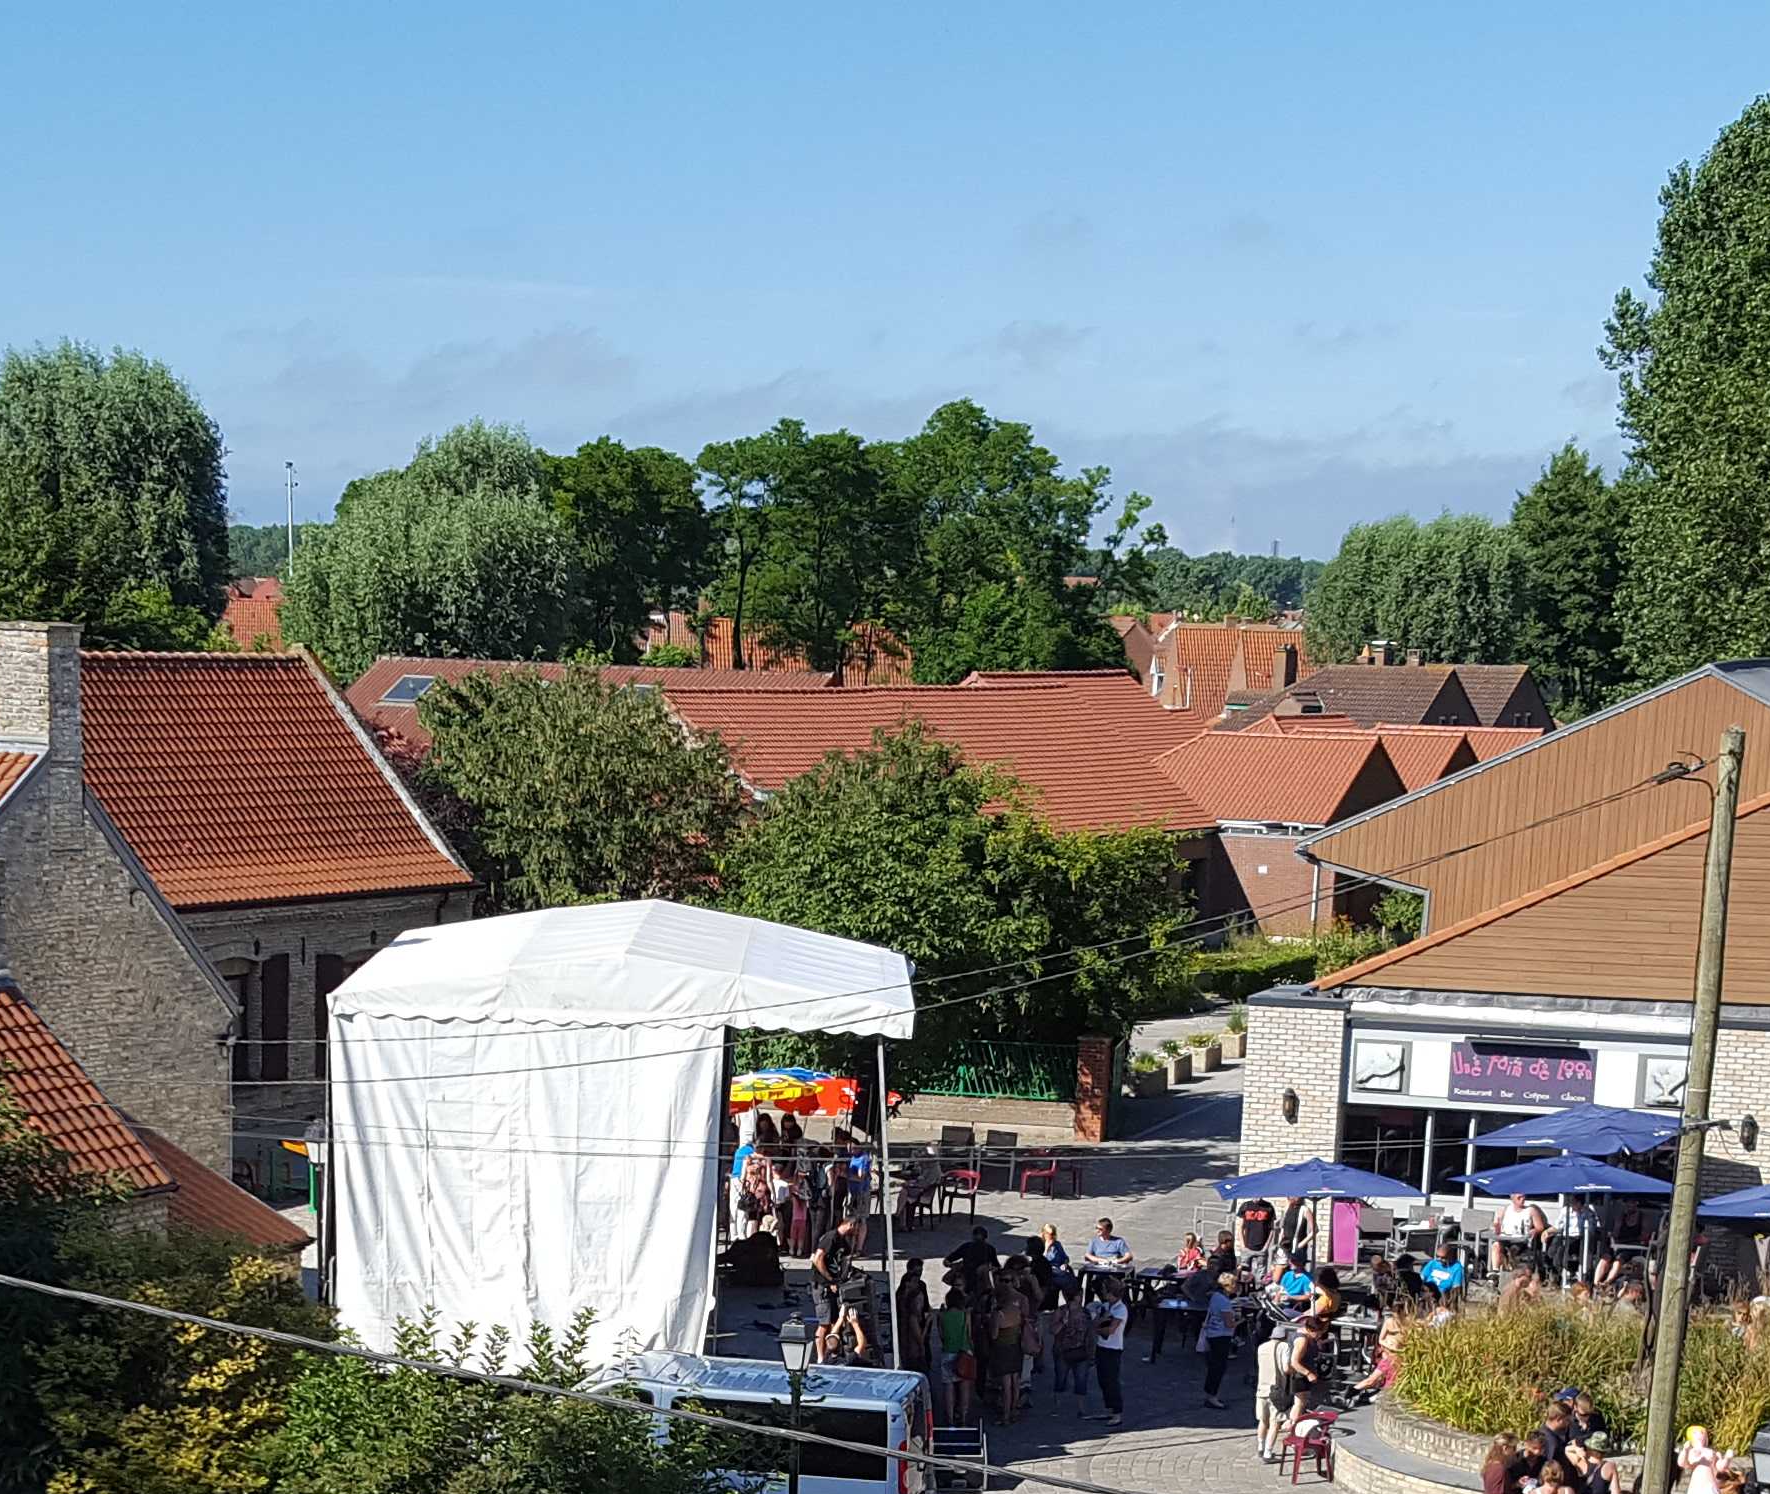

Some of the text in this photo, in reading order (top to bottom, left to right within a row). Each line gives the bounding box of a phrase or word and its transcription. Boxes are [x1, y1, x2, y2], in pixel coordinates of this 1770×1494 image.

[1452, 1051, 1593, 1080] Une Faim de Loon
[1453, 1087, 1493, 1098] Restaurant
[1500, 1089, 1515, 1098] Bar
[1560, 1092, 1586, 1102] Glaces
